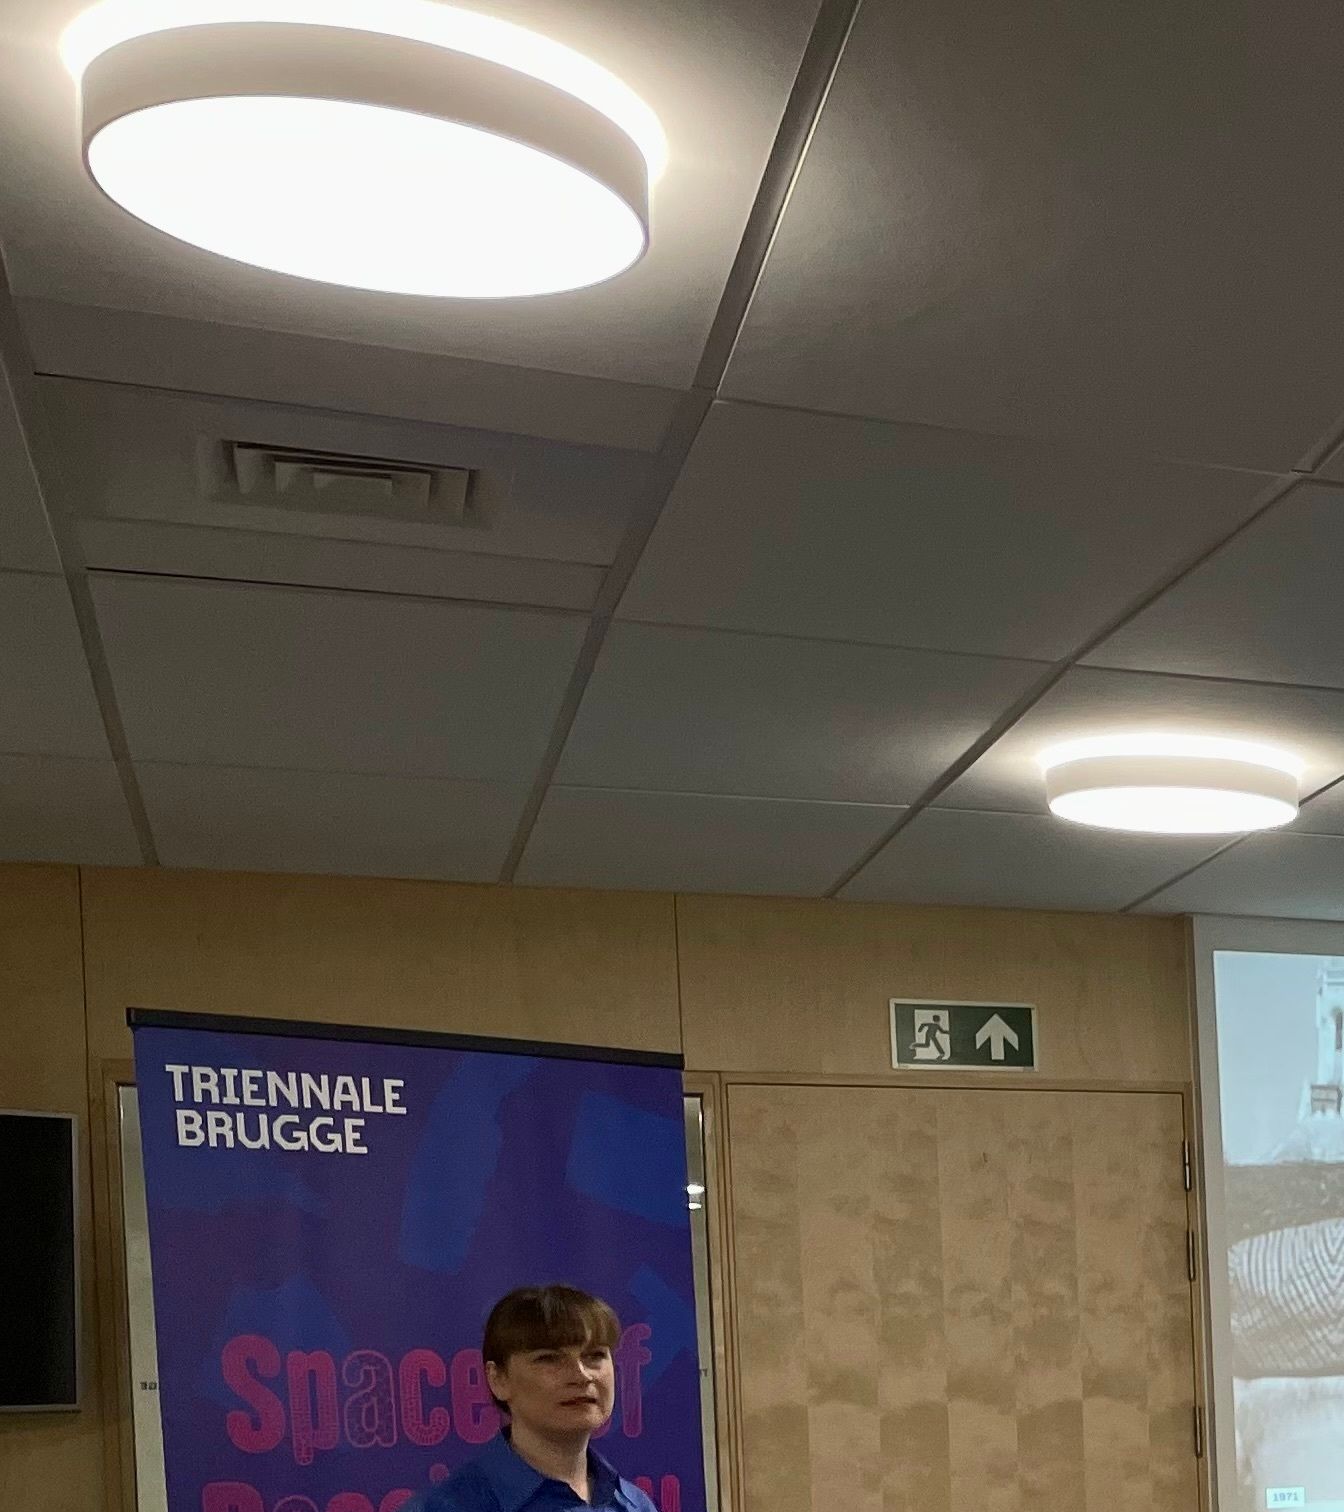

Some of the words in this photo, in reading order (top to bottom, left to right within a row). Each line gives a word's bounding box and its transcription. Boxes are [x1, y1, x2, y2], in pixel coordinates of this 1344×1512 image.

[165, 1064, 407, 1115] TRIENNALE
[176, 1109, 368, 1154] BRUGGE
[221, 1333, 508, 1466] Space
